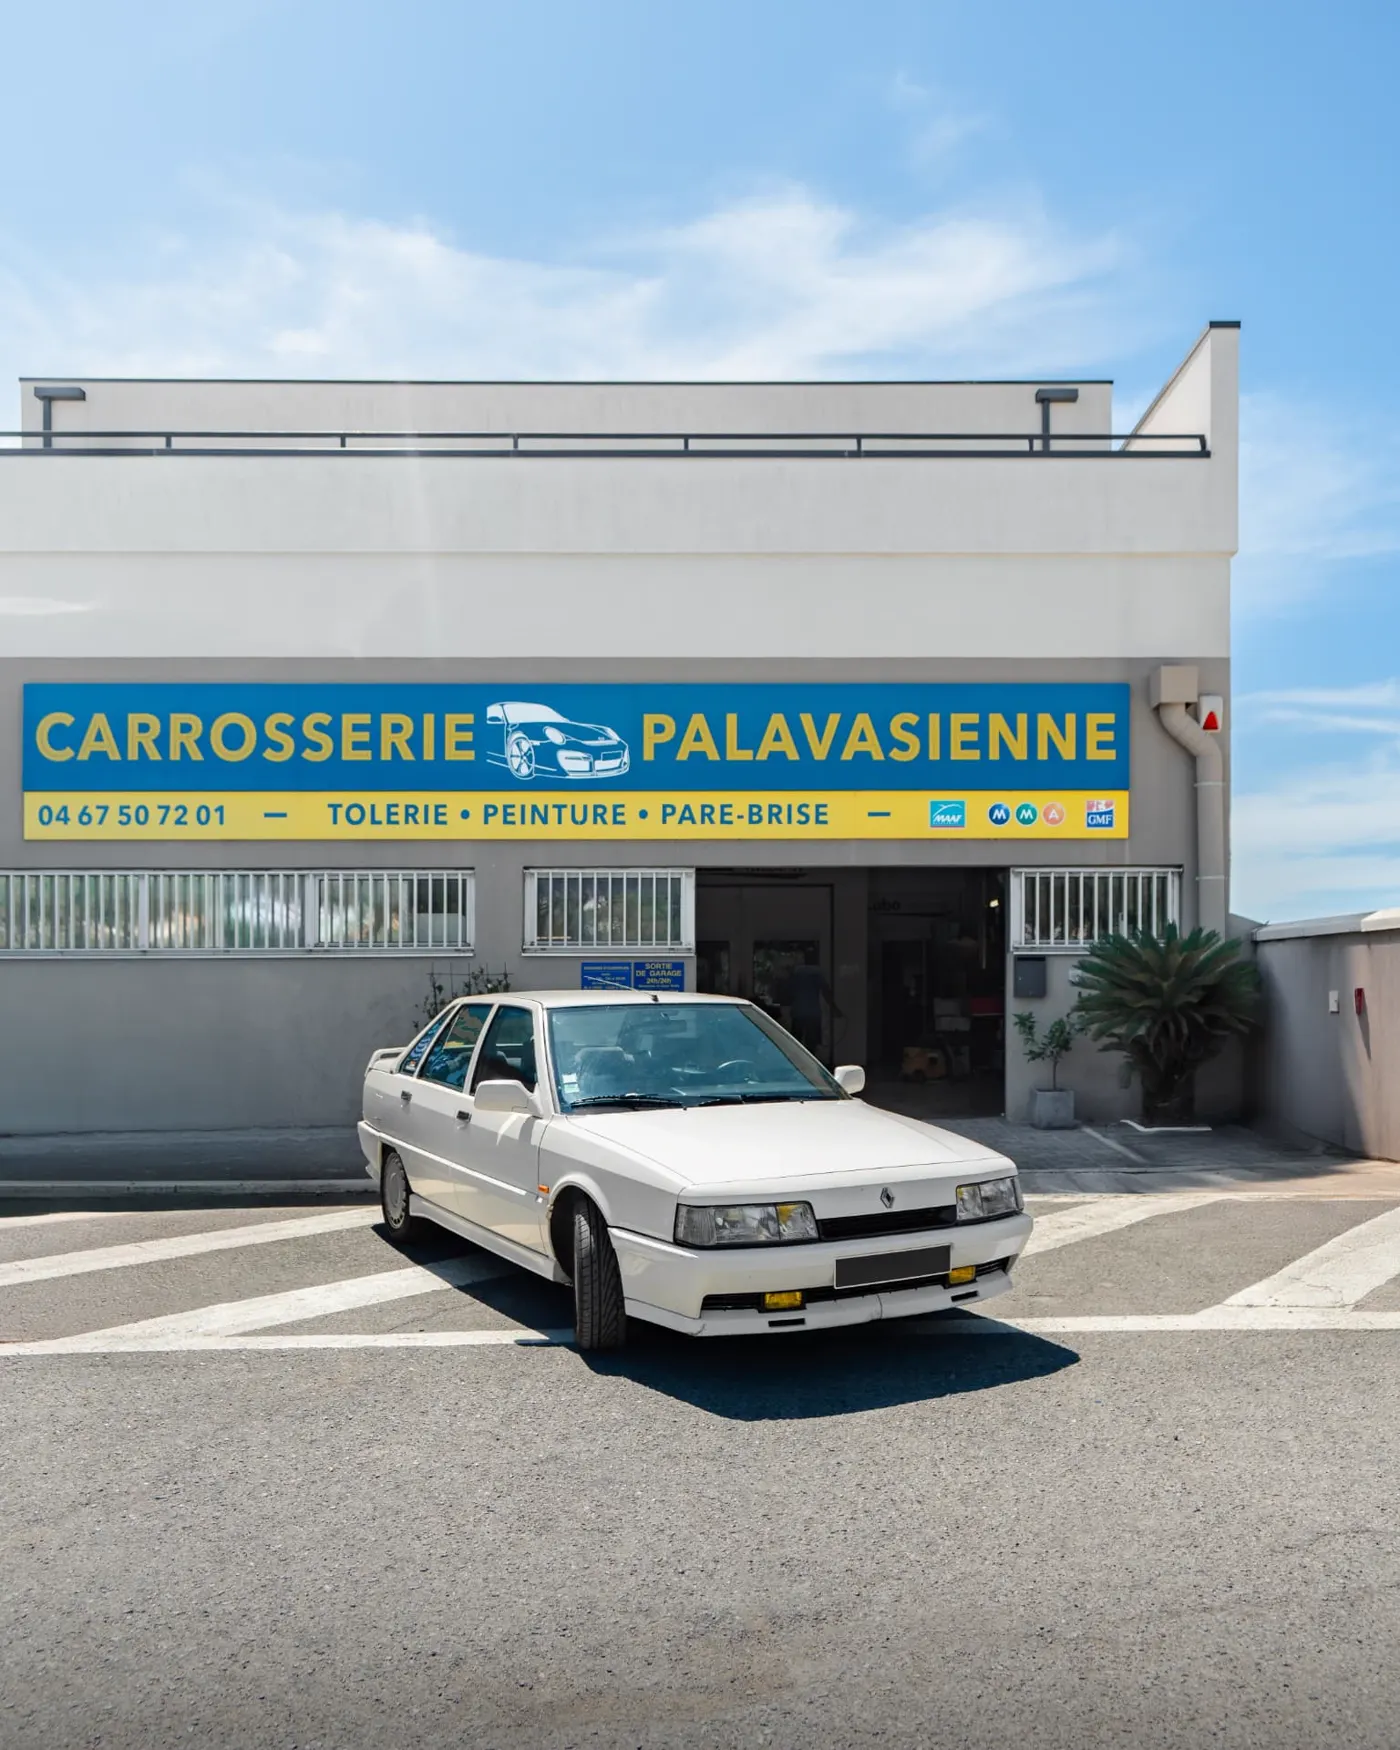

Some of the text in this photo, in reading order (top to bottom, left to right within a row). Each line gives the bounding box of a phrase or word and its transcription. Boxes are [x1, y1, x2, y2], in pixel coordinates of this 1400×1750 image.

[36, 712, 1117, 762] CARROSSERIE PALAVASIENNE
[327, 802, 829, 826] TOLERIE PEINTURE PARE-BRISE
[1088, 814, 1112, 825] GMF
